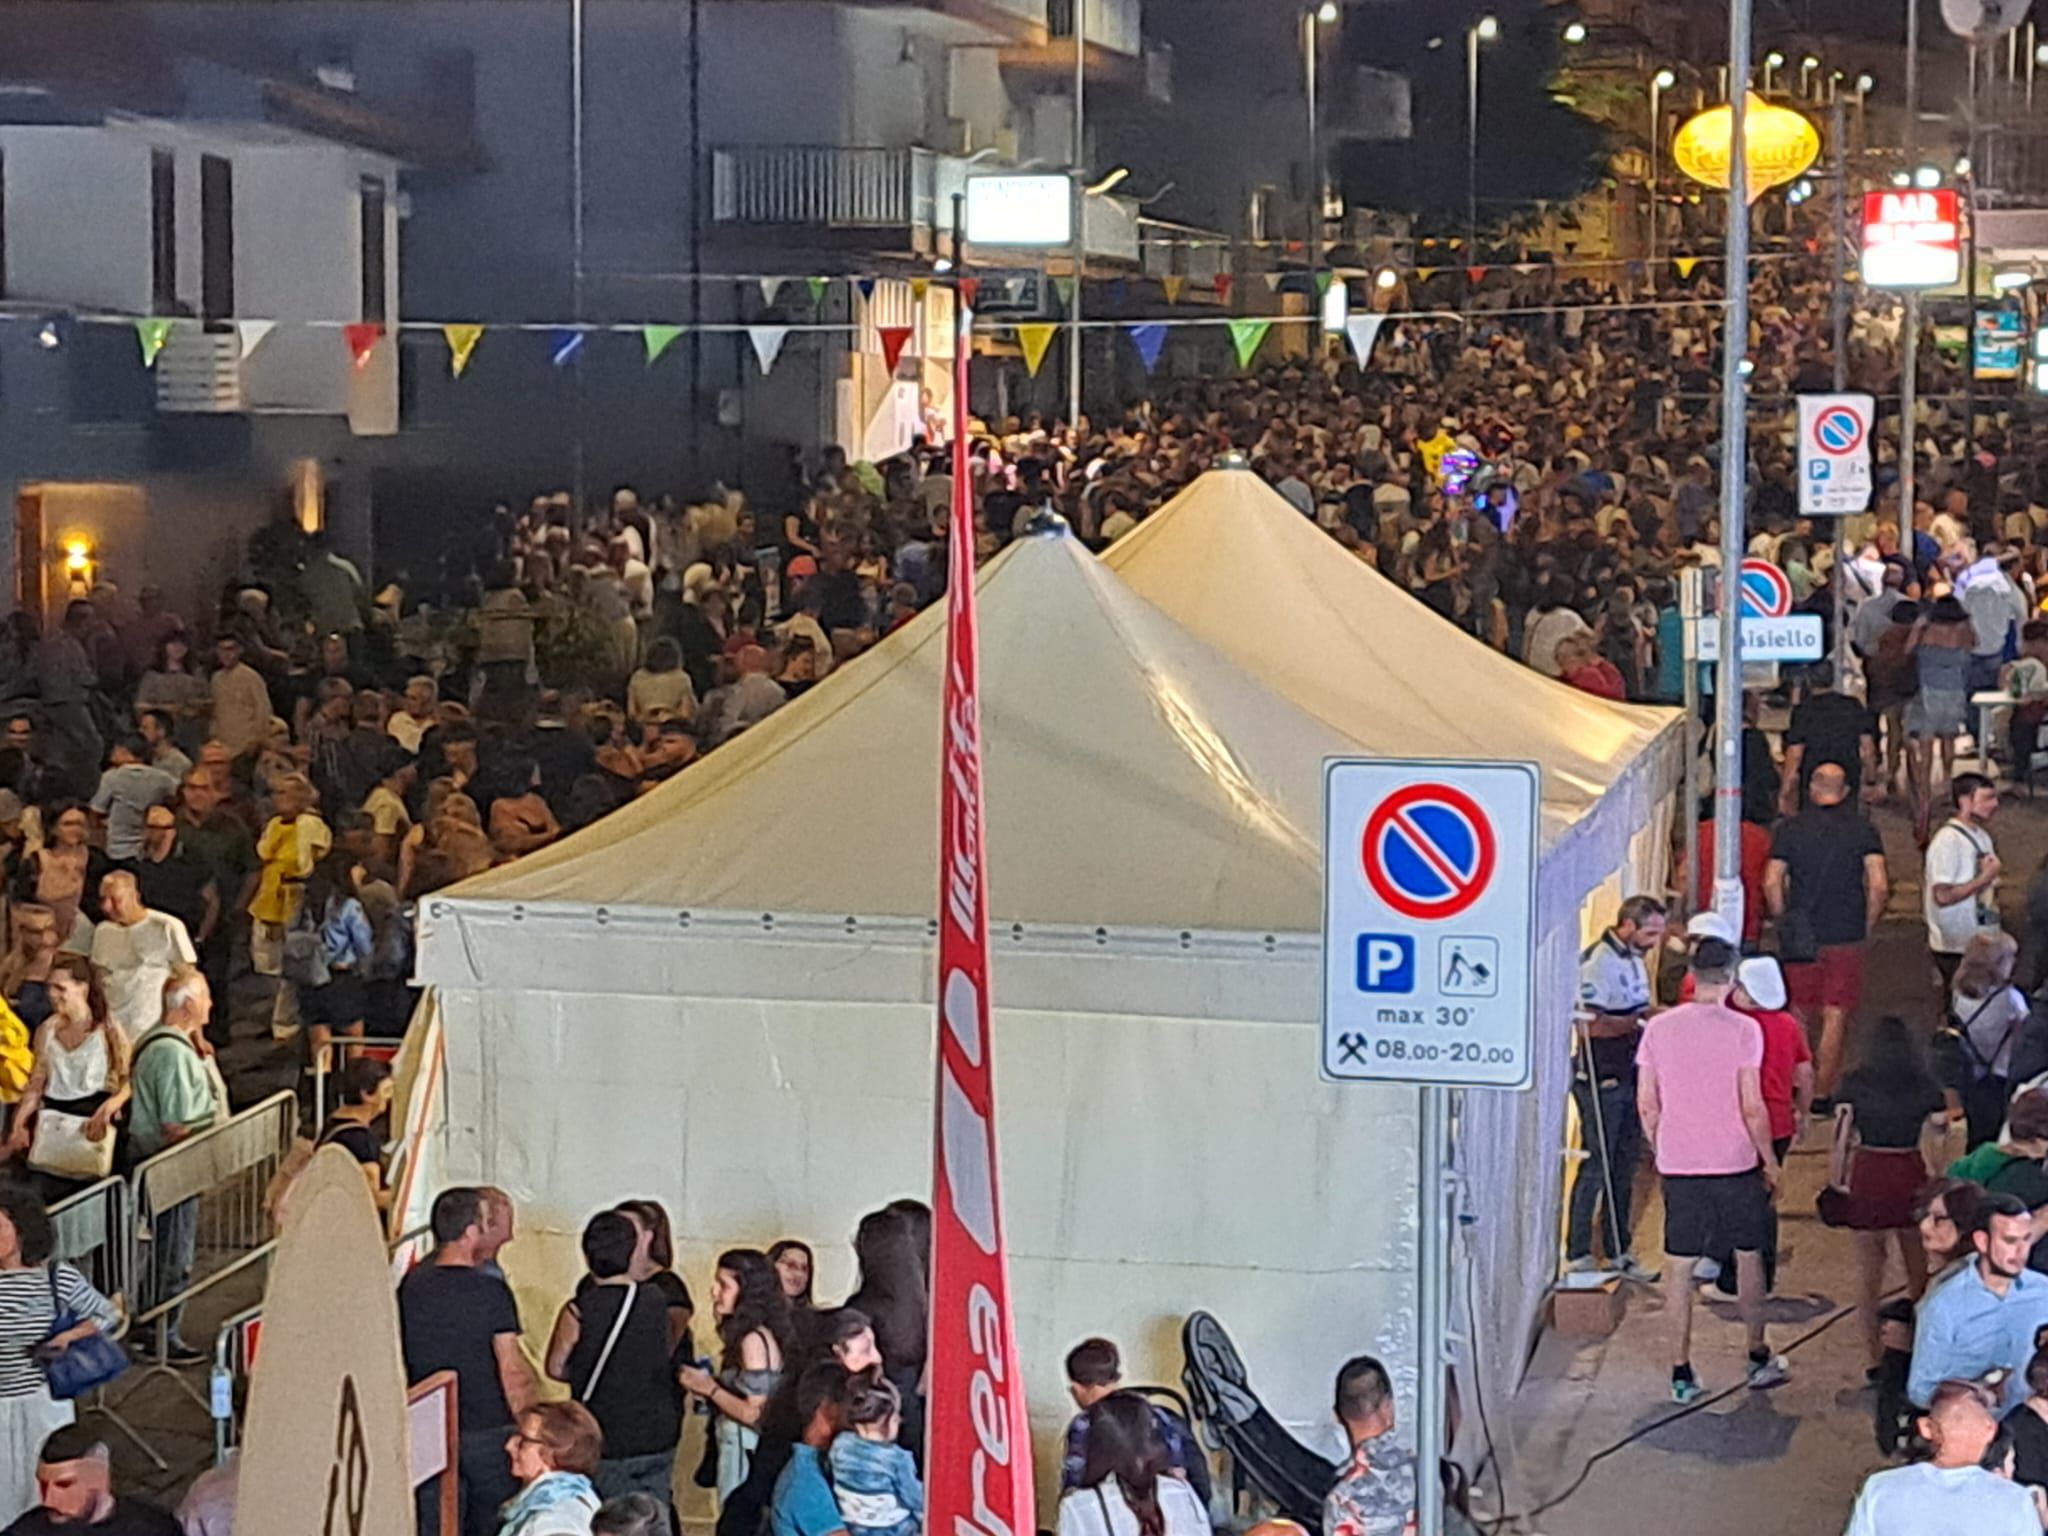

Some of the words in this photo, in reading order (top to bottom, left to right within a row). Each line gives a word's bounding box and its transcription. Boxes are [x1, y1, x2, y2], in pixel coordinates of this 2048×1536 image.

[1742, 629, 1816, 648] isiello
[1367, 939, 1404, 986] P
[1376, 1008, 1425, 1025] max
[1375, 1039, 1514, 1063] 08.00-20.00
